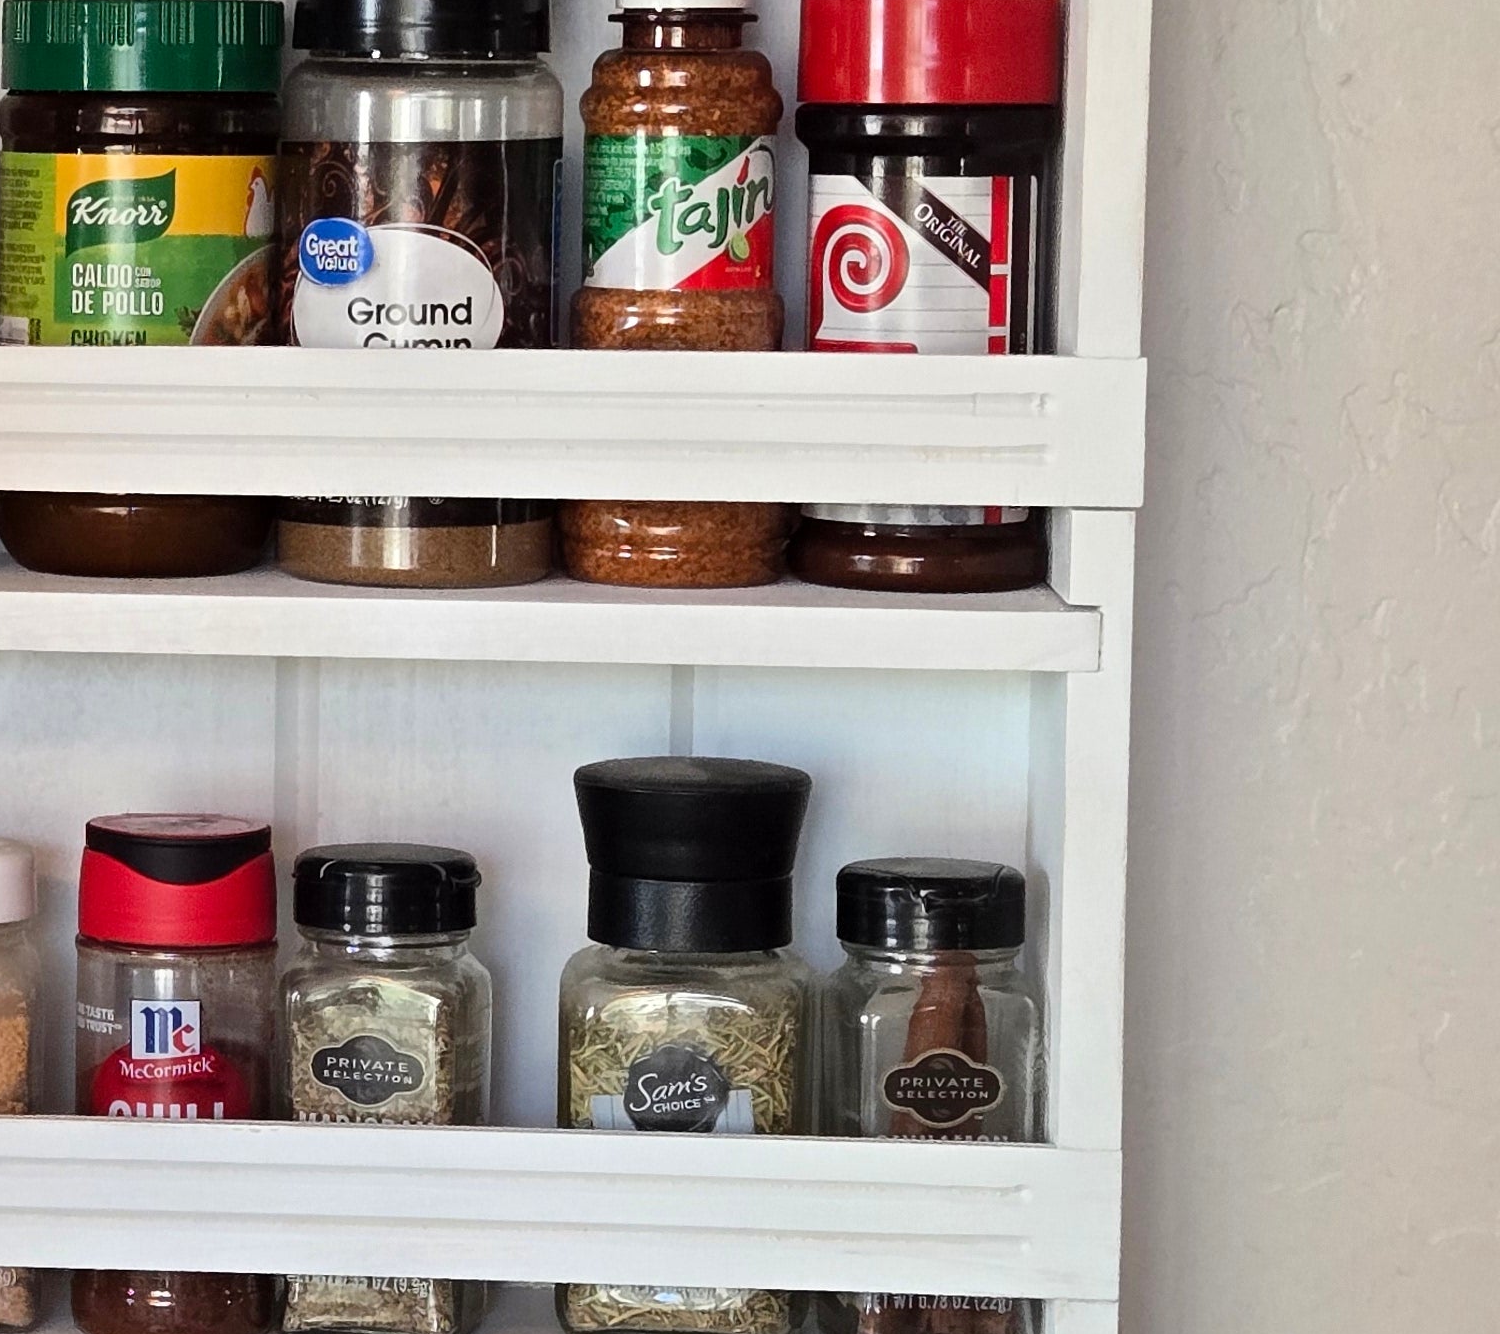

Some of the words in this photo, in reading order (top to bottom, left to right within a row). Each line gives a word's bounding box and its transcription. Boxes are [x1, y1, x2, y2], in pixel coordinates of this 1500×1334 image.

[71, 196, 168, 226] Knorr
[913, 202, 982, 269] ORIGINAL
[946, 215, 969, 238] THE
[305, 234, 359, 257] Great
[315, 254, 358, 271] Value
[72, 263, 132, 288] CALDO
[72, 291, 94, 315] DE
[102, 291, 164, 316] POLLO
[347, 296, 472, 326] Ground
[119, 1057, 214, 1080] McCormick
[327, 1057, 409, 1073] PRIVATE
[323, 1069, 413, 1085] SELECTION
[900, 1077, 984, 1088] PRIVATE
[629, 1073, 708, 1112] Sam's
[896, 1090, 989, 1100] SELECTION
[652, 1098, 701, 1114] CHOICE
